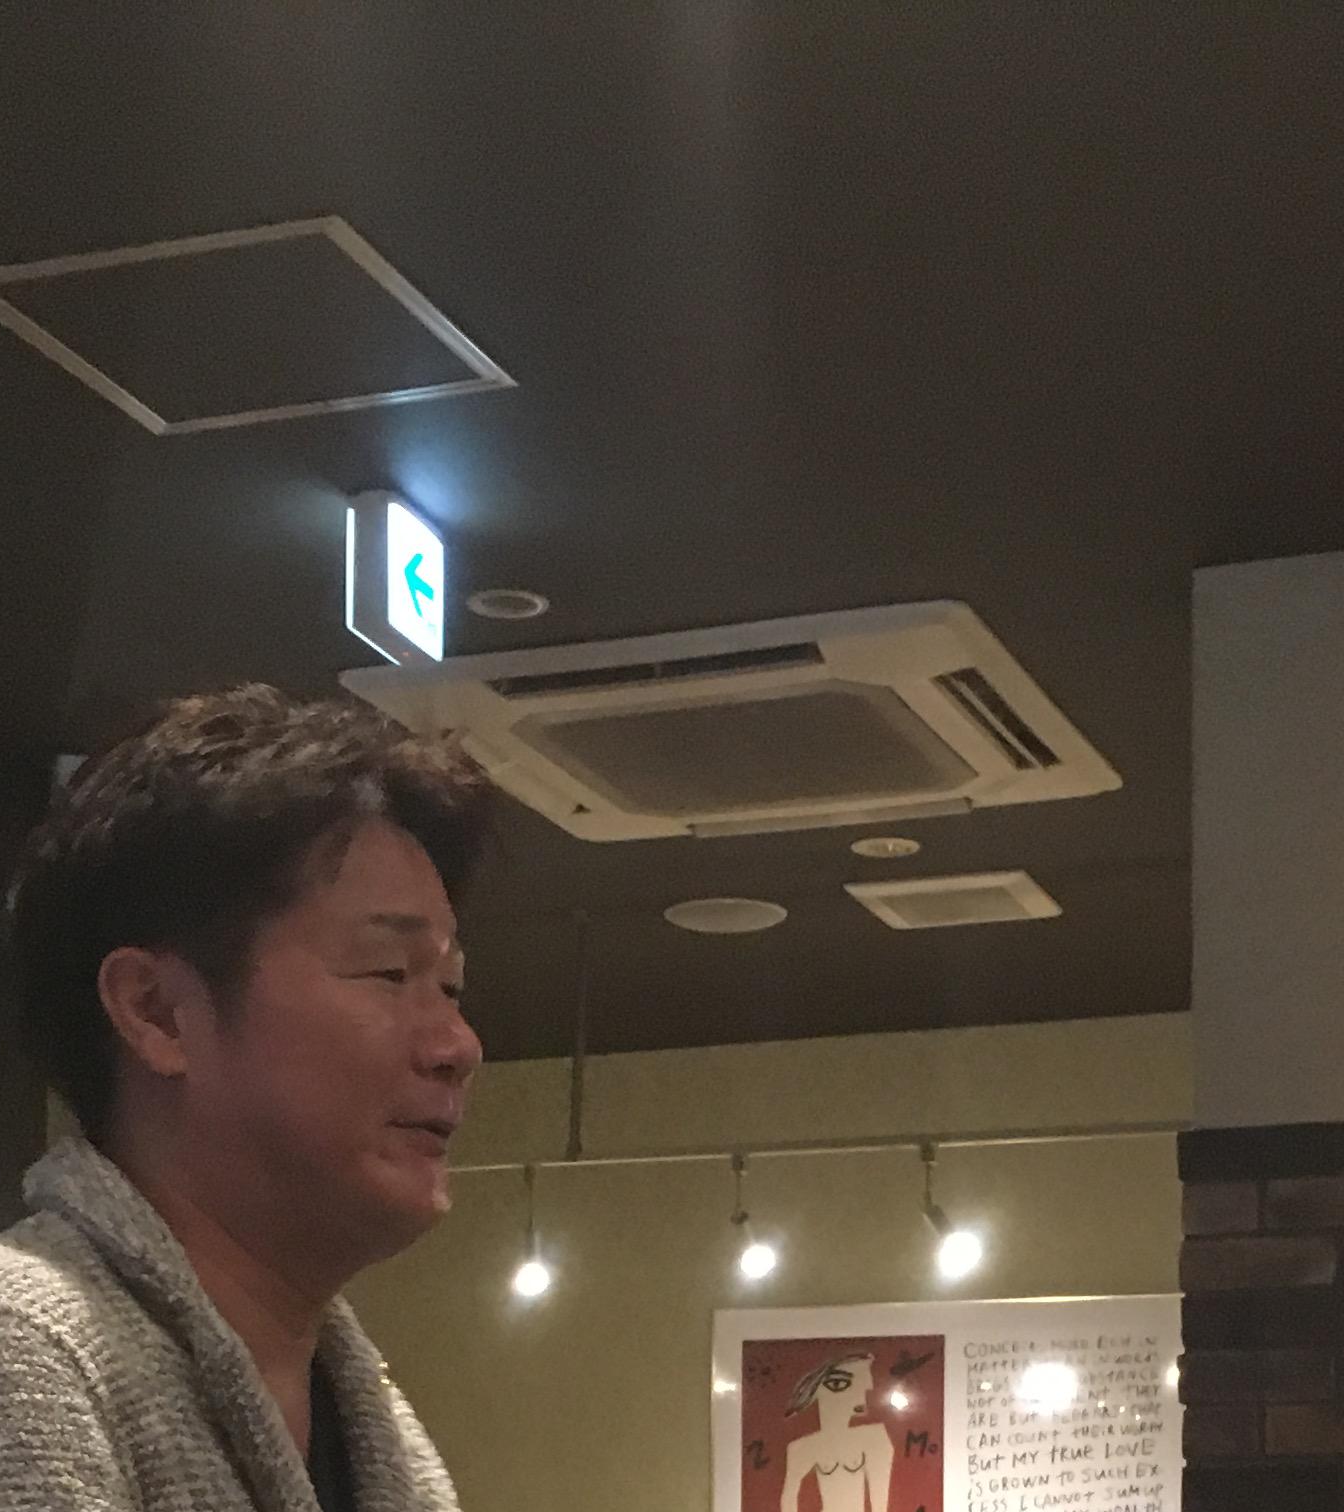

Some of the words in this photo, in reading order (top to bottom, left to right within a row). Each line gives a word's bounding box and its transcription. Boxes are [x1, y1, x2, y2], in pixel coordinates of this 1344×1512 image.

[1012, 1450, 1039, 1468] MY
[1105, 1438, 1156, 1459] LOVE
[989, 1474, 1050, 1493] GROWN
[1081, 1463, 1128, 1484] SUCH
